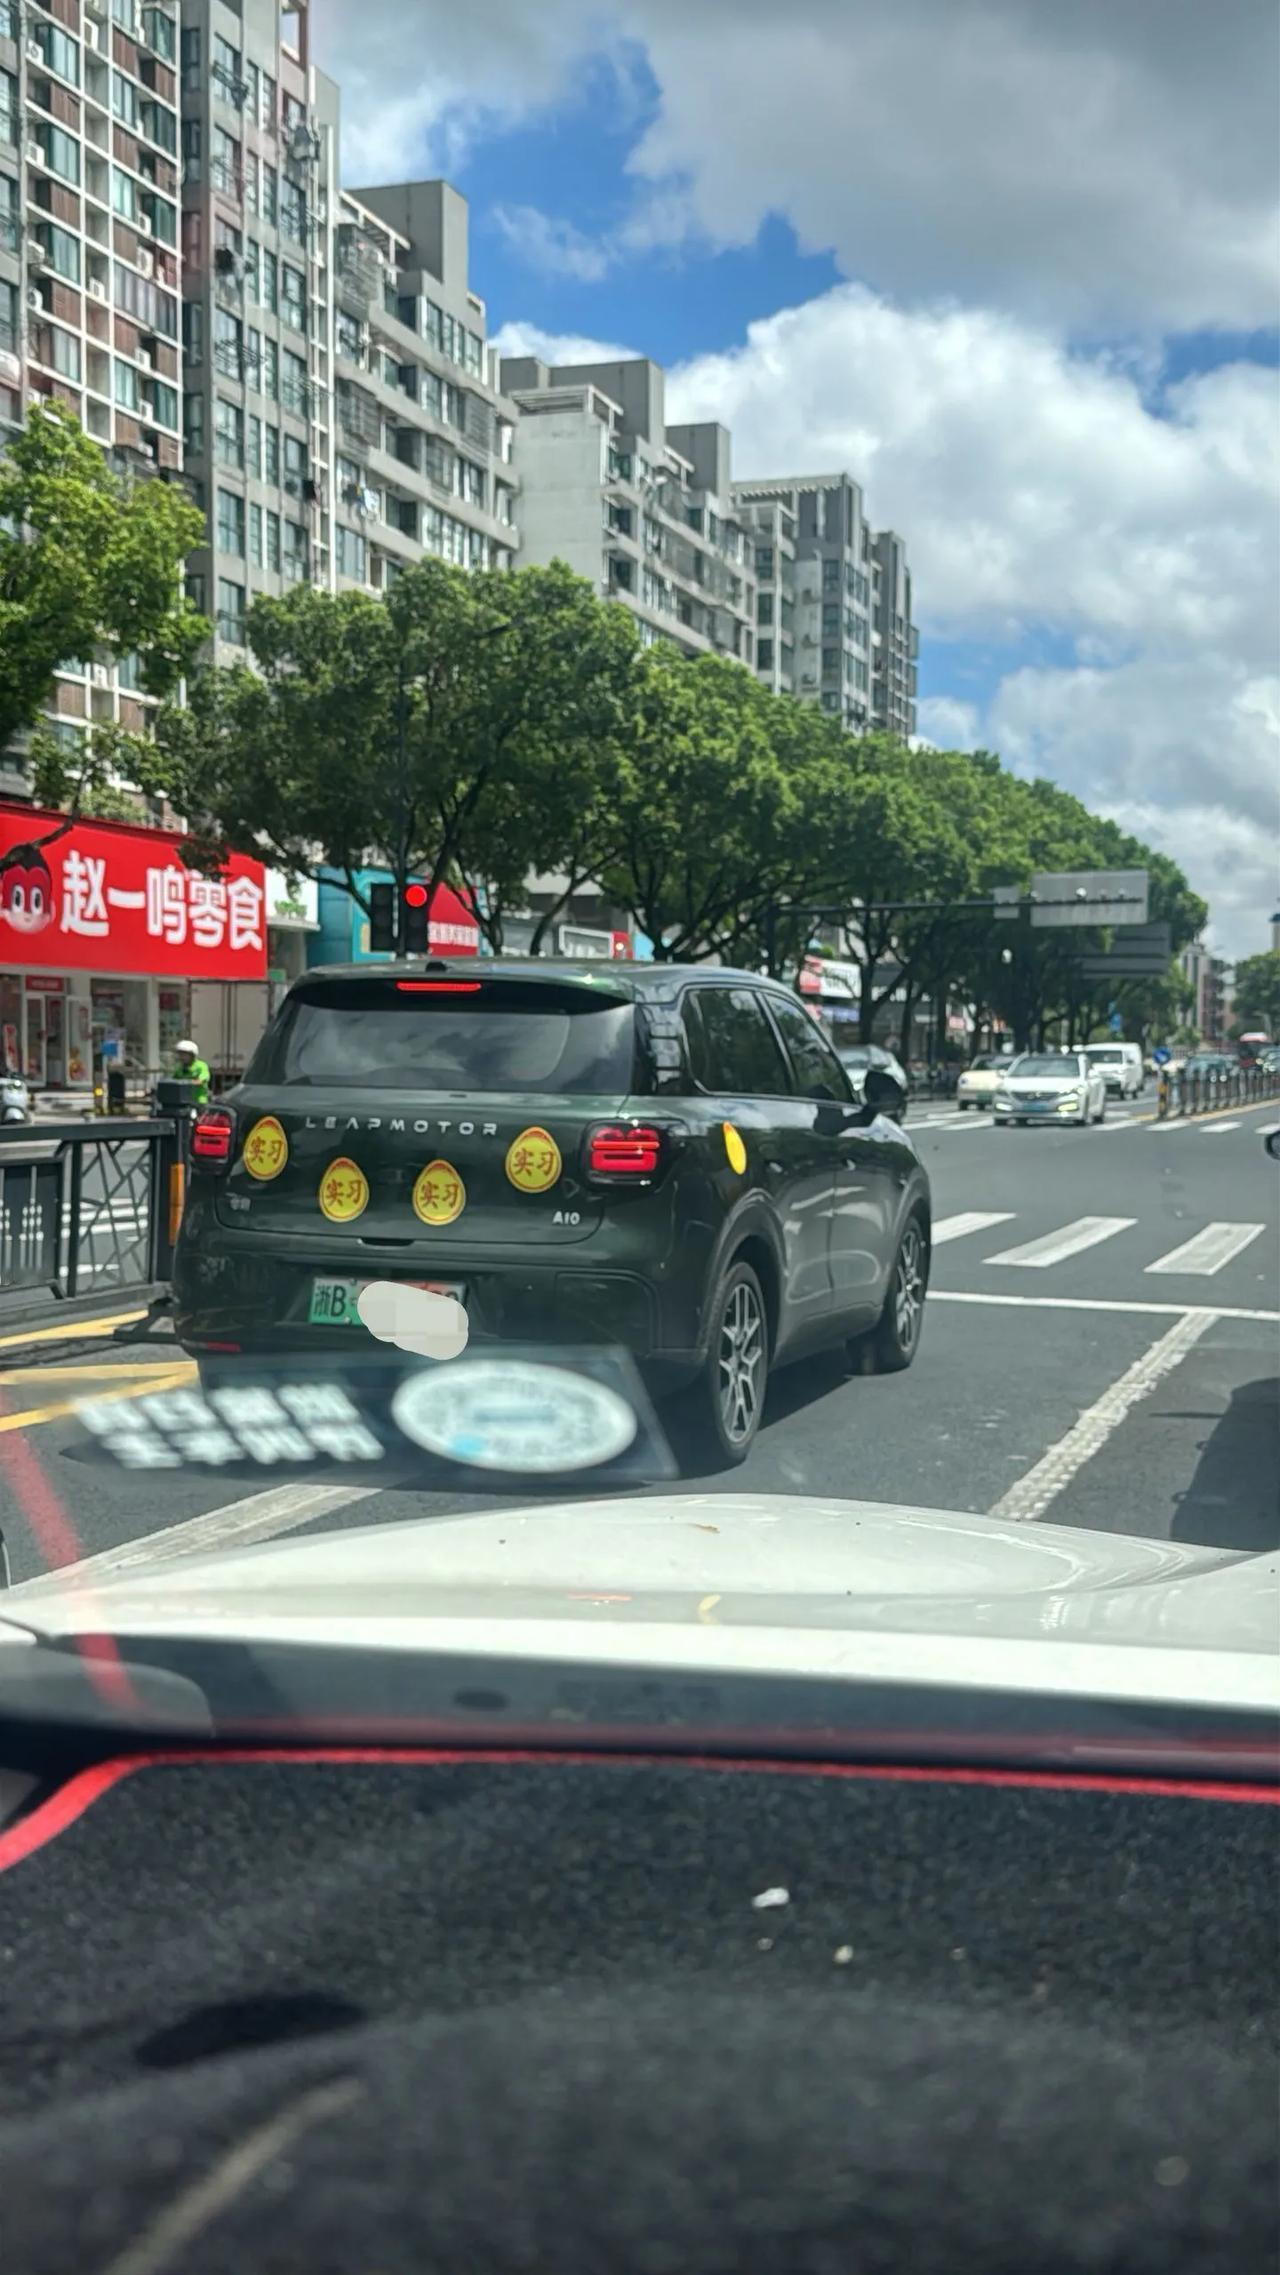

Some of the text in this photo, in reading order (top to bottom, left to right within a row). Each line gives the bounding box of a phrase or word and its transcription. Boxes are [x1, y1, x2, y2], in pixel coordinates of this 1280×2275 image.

[60, 849, 264, 951] 赵一鸣零食
[304, 1116, 498, 1136] LEAPMOTOR
[250, 1136, 284, 1164] 实习
[513, 1147, 554, 1176] 实习
[325, 1178, 362, 1207] 实习
[420, 1180, 459, 1209] 实习
[552, 1210, 581, 1225] A10
